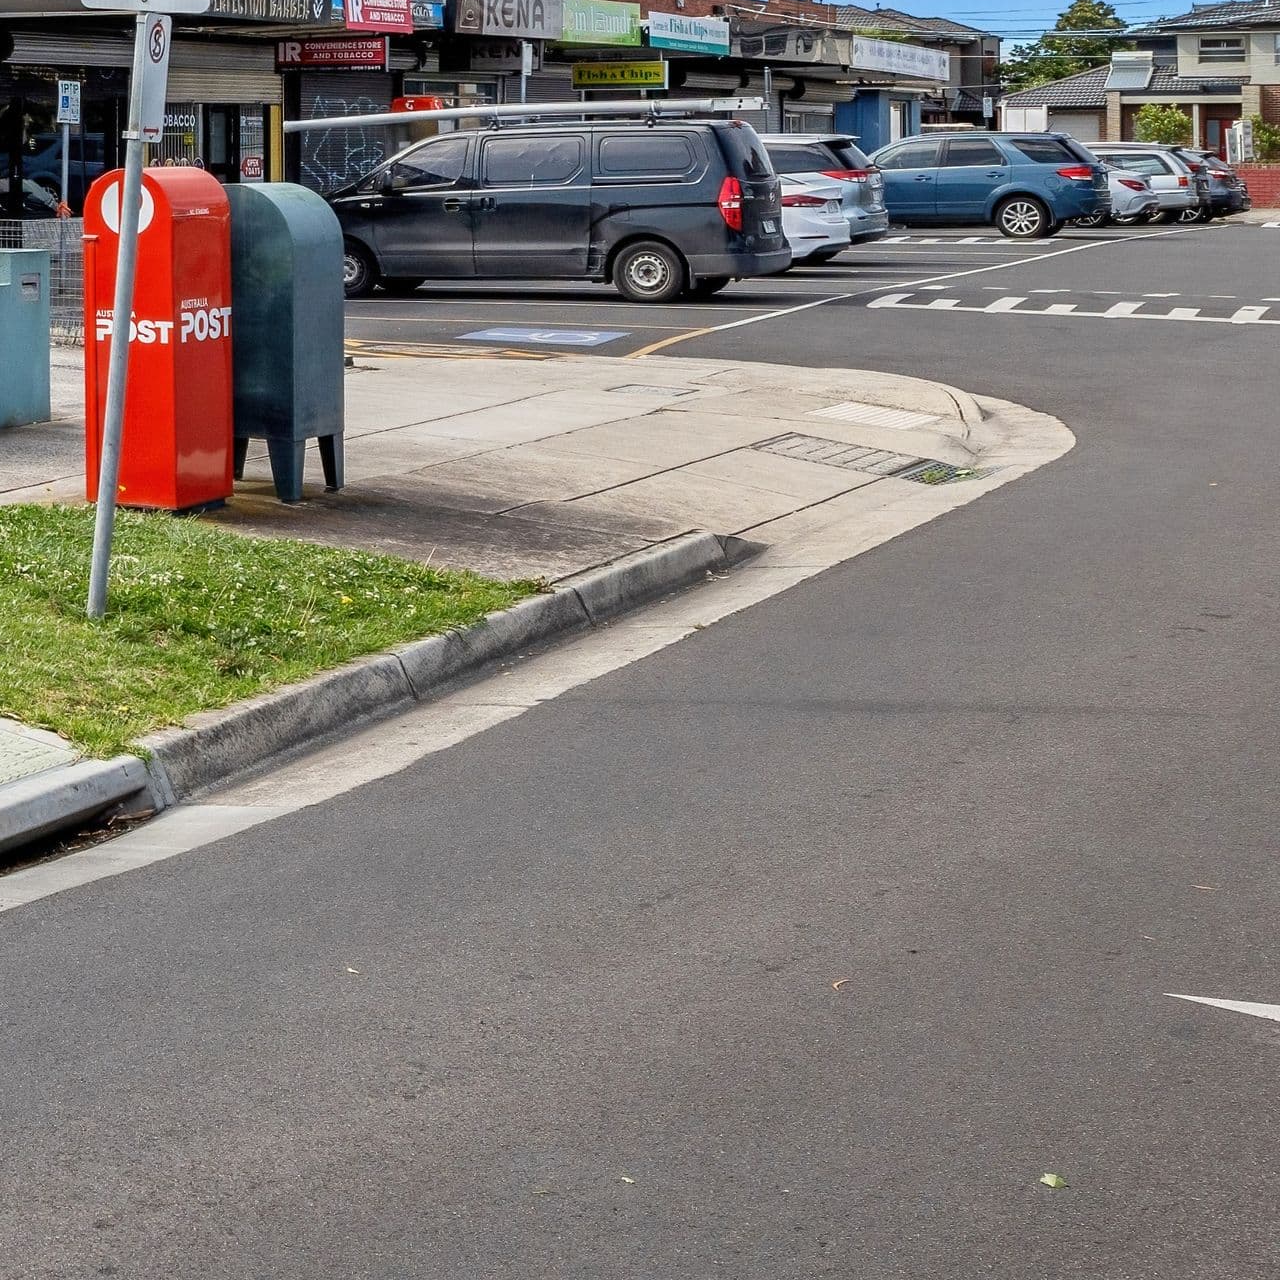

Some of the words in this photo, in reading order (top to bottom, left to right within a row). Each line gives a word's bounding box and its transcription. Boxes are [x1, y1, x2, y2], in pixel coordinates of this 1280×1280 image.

[369, 11, 381, 21] AND
[382, 12, 405, 23] TOBACCO
[304, 41, 357, 50] CONVENIENCE
[278, 42, 301, 62] IR
[333, 51, 374, 59] TOBACCO
[163, 114, 196, 127] OBACCO
[180, 298, 208, 309] AUSTRALIA
[180, 307, 232, 343] POST
